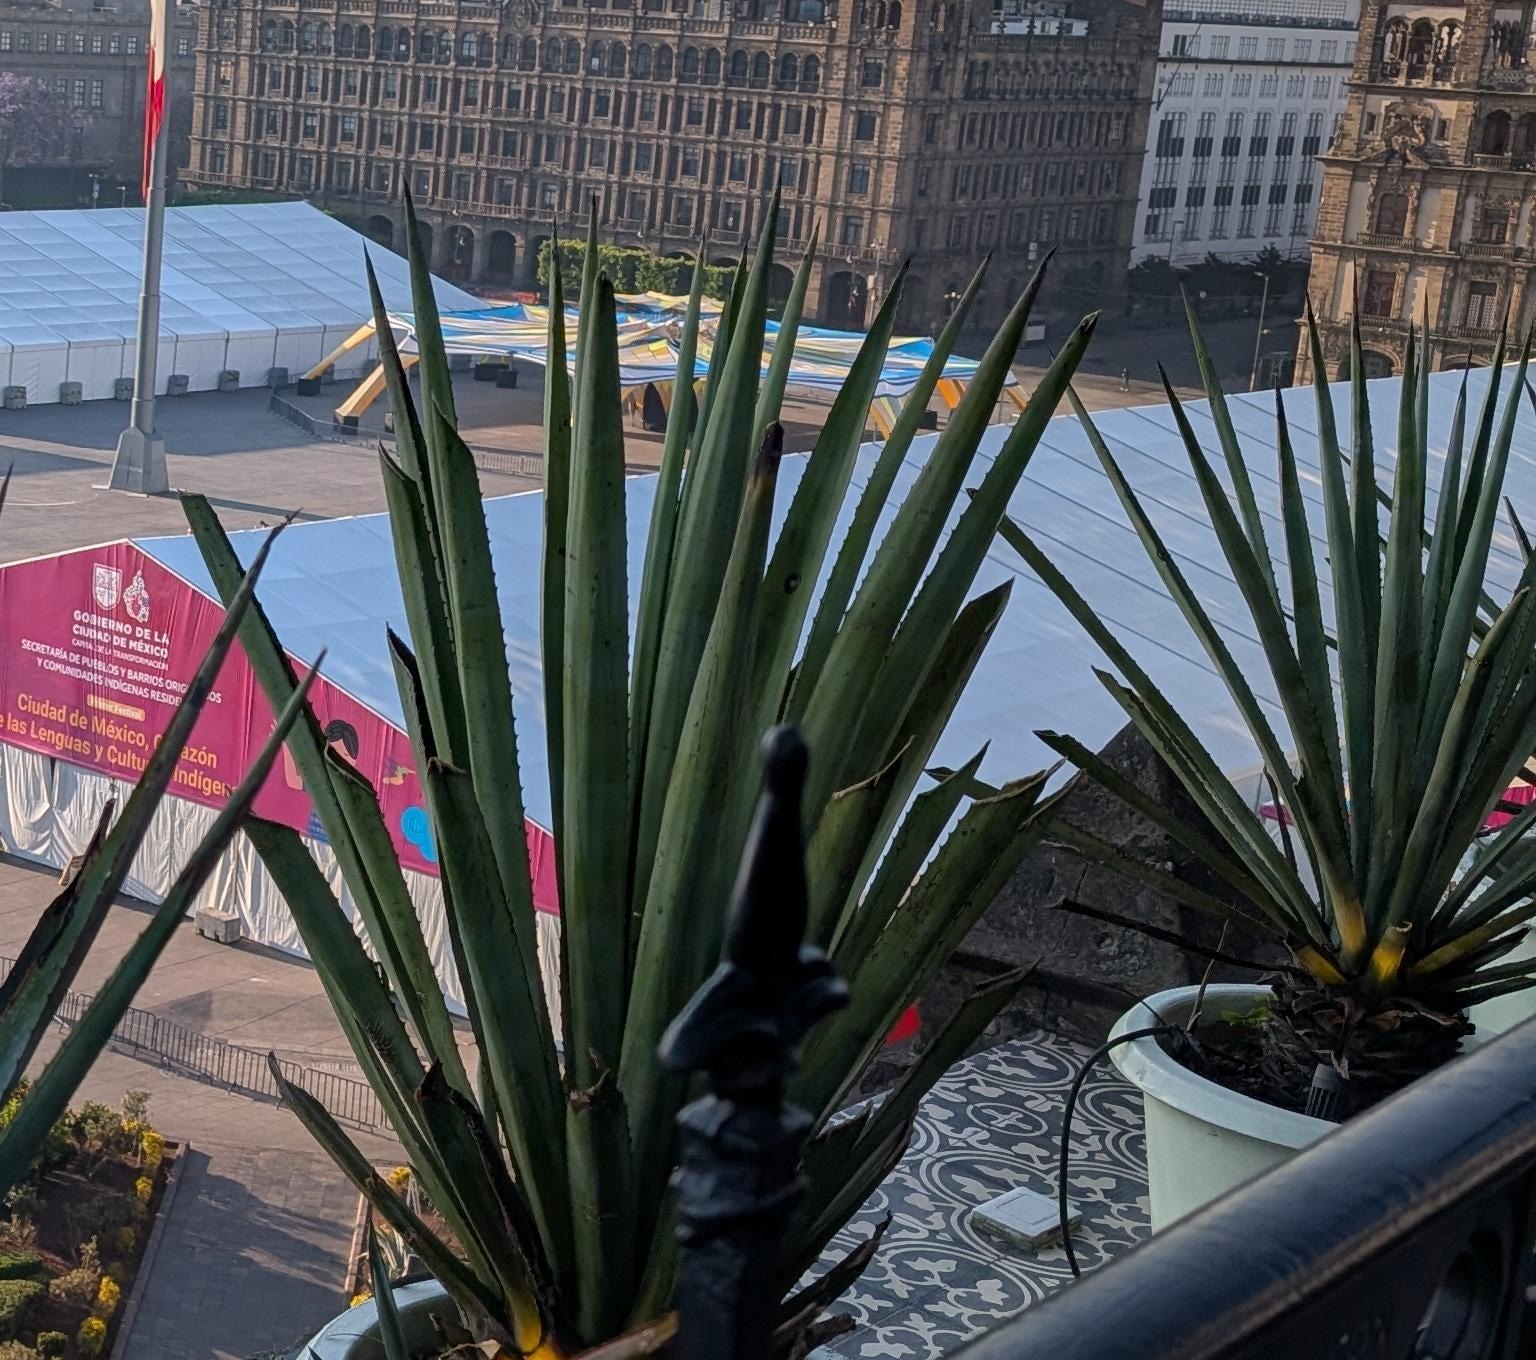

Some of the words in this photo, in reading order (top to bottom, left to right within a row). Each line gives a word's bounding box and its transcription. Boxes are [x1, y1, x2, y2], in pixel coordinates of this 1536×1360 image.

[72, 624, 112, 643] CIUDAD
[112, 635, 127, 648] DE
[129, 640, 168, 658] MÉXICO
[73, 610, 133, 635] GOBIERNO
[135, 626, 152, 640] DE
[154, 631, 169, 645] LA
[21, 638, 68, 661] SECRETARÍA
[69, 652, 81, 665] DE
[82, 656, 119, 676] PUEBLOS
[119, 667, 127, 678] Y
[127, 669, 164, 688] BARRIOS
[36, 657, 44, 667] Y
[43, 659, 104, 685] COMUNIDADES
[105, 677, 149, 698] INDÍGENAS
[7, 712, 27, 735] las
[30, 720, 91, 755] Lenguas
[94, 744, 104, 763] y
[107, 745, 149, 772] Cultu
[18, 693, 67, 723] Ciudad
[69, 709, 88, 729] de
[92, 716, 149, 751] México,
